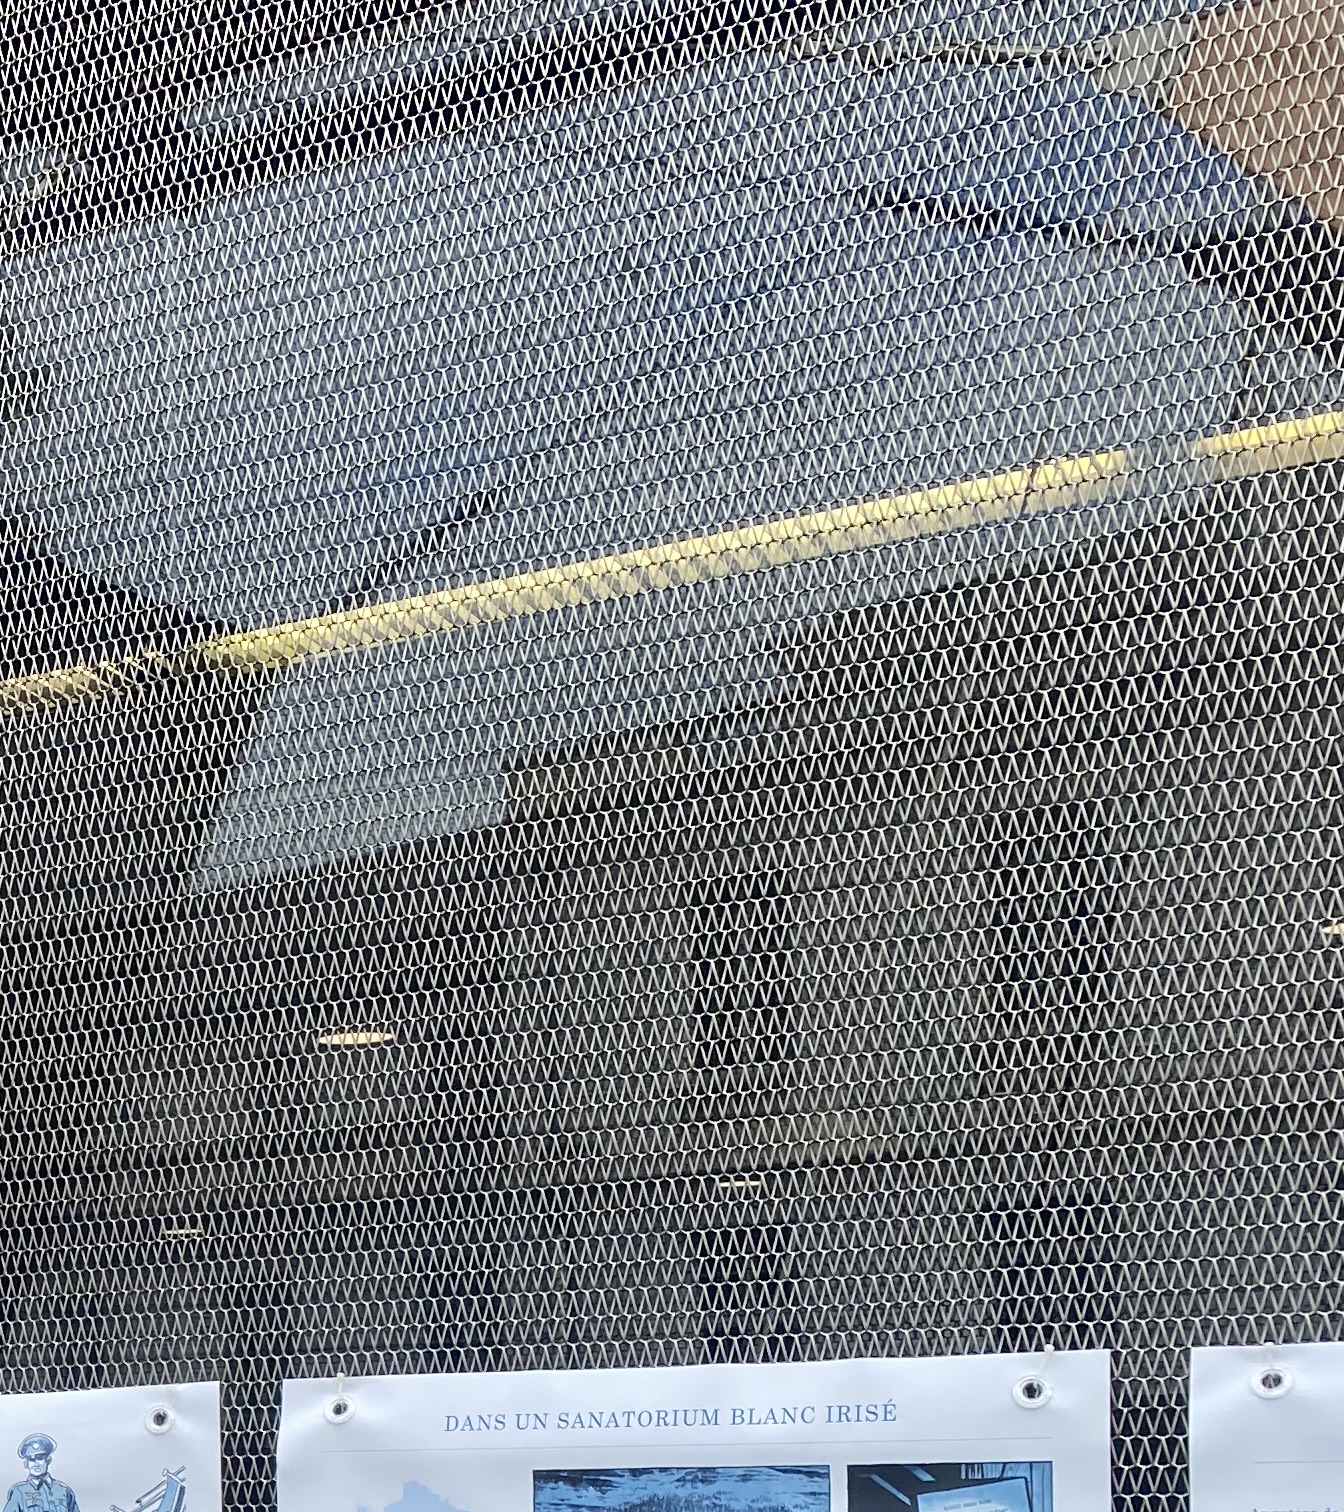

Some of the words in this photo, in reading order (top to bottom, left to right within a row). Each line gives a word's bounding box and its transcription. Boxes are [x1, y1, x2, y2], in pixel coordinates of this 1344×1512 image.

[444, 1413, 505, 1433] DANS
[515, 1412, 549, 1431] UN
[556, 1407, 720, 1430] SANATORIUM
[729, 1405, 815, 1425] BLANC
[825, 1397, 900, 1423] IRISÉ
